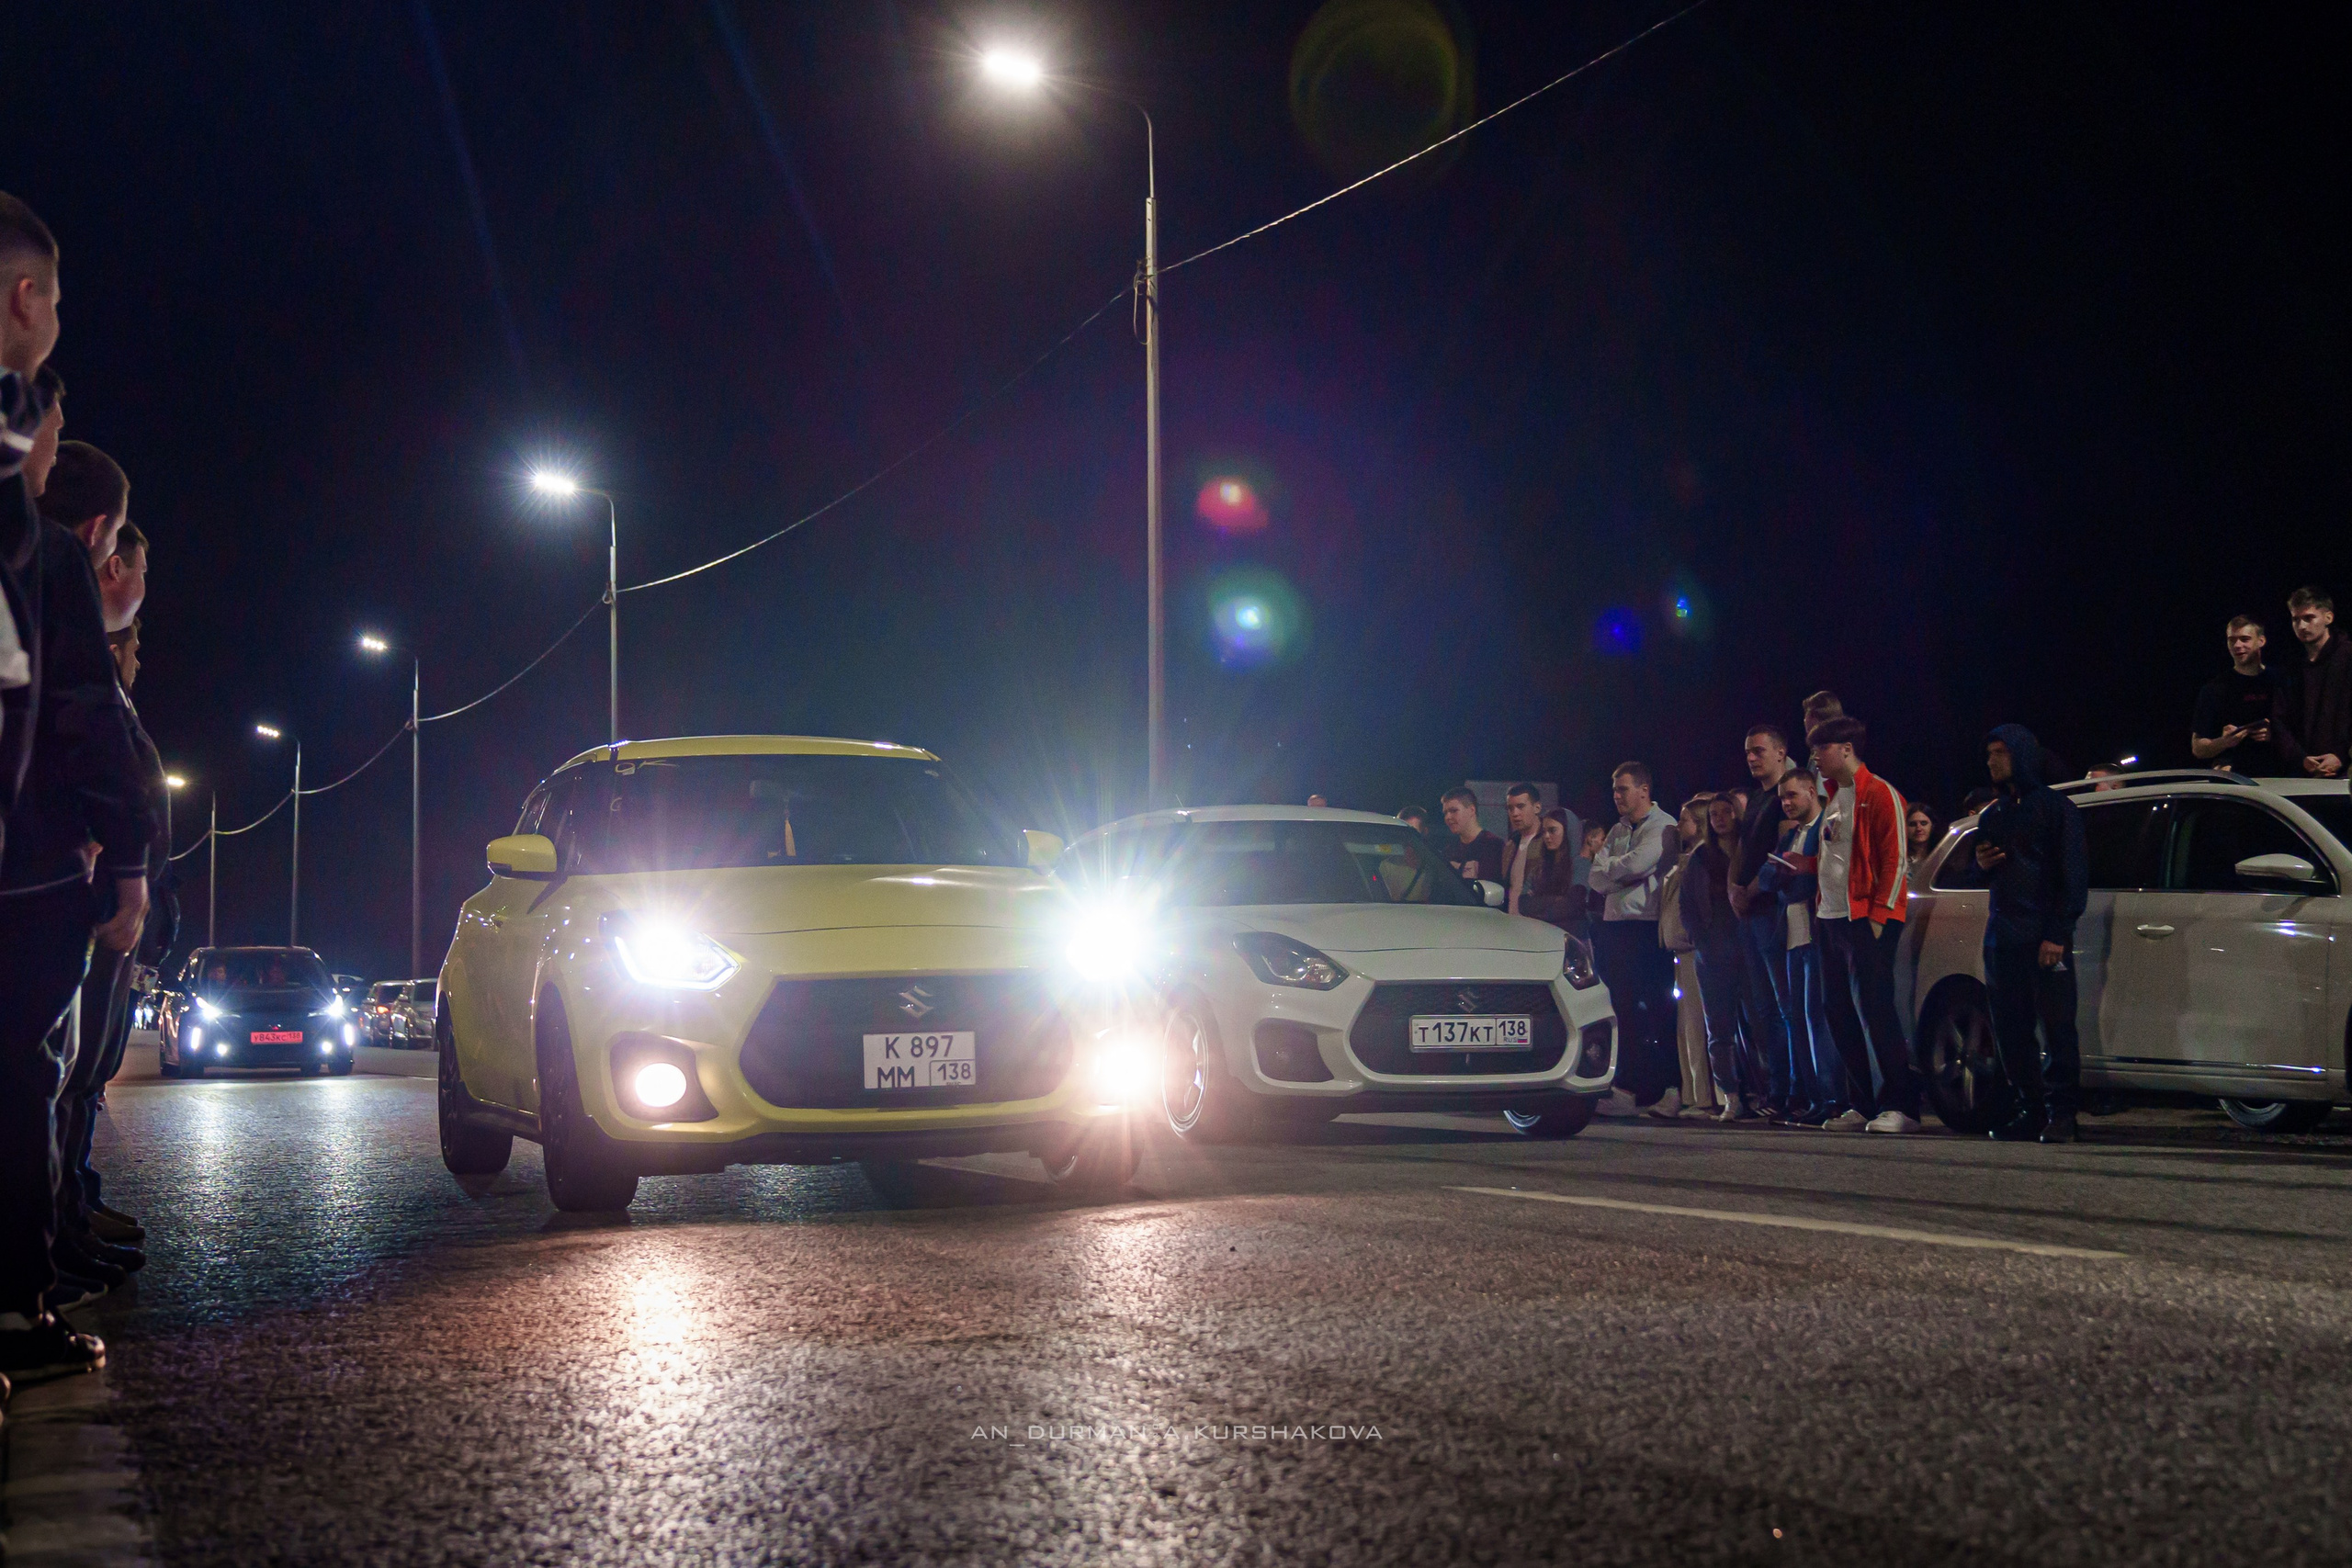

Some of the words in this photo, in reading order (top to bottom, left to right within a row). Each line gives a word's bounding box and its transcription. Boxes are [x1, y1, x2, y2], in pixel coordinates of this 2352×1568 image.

[1418, 1021, 1494, 1043] Т137КТ
[1498, 1020, 1526, 1036] 138
[885, 1036, 900, 1059] К
[910, 1034, 955, 1058] 897
[876, 1066, 915, 1088] ММ
[937, 1062, 971, 1080] 138
